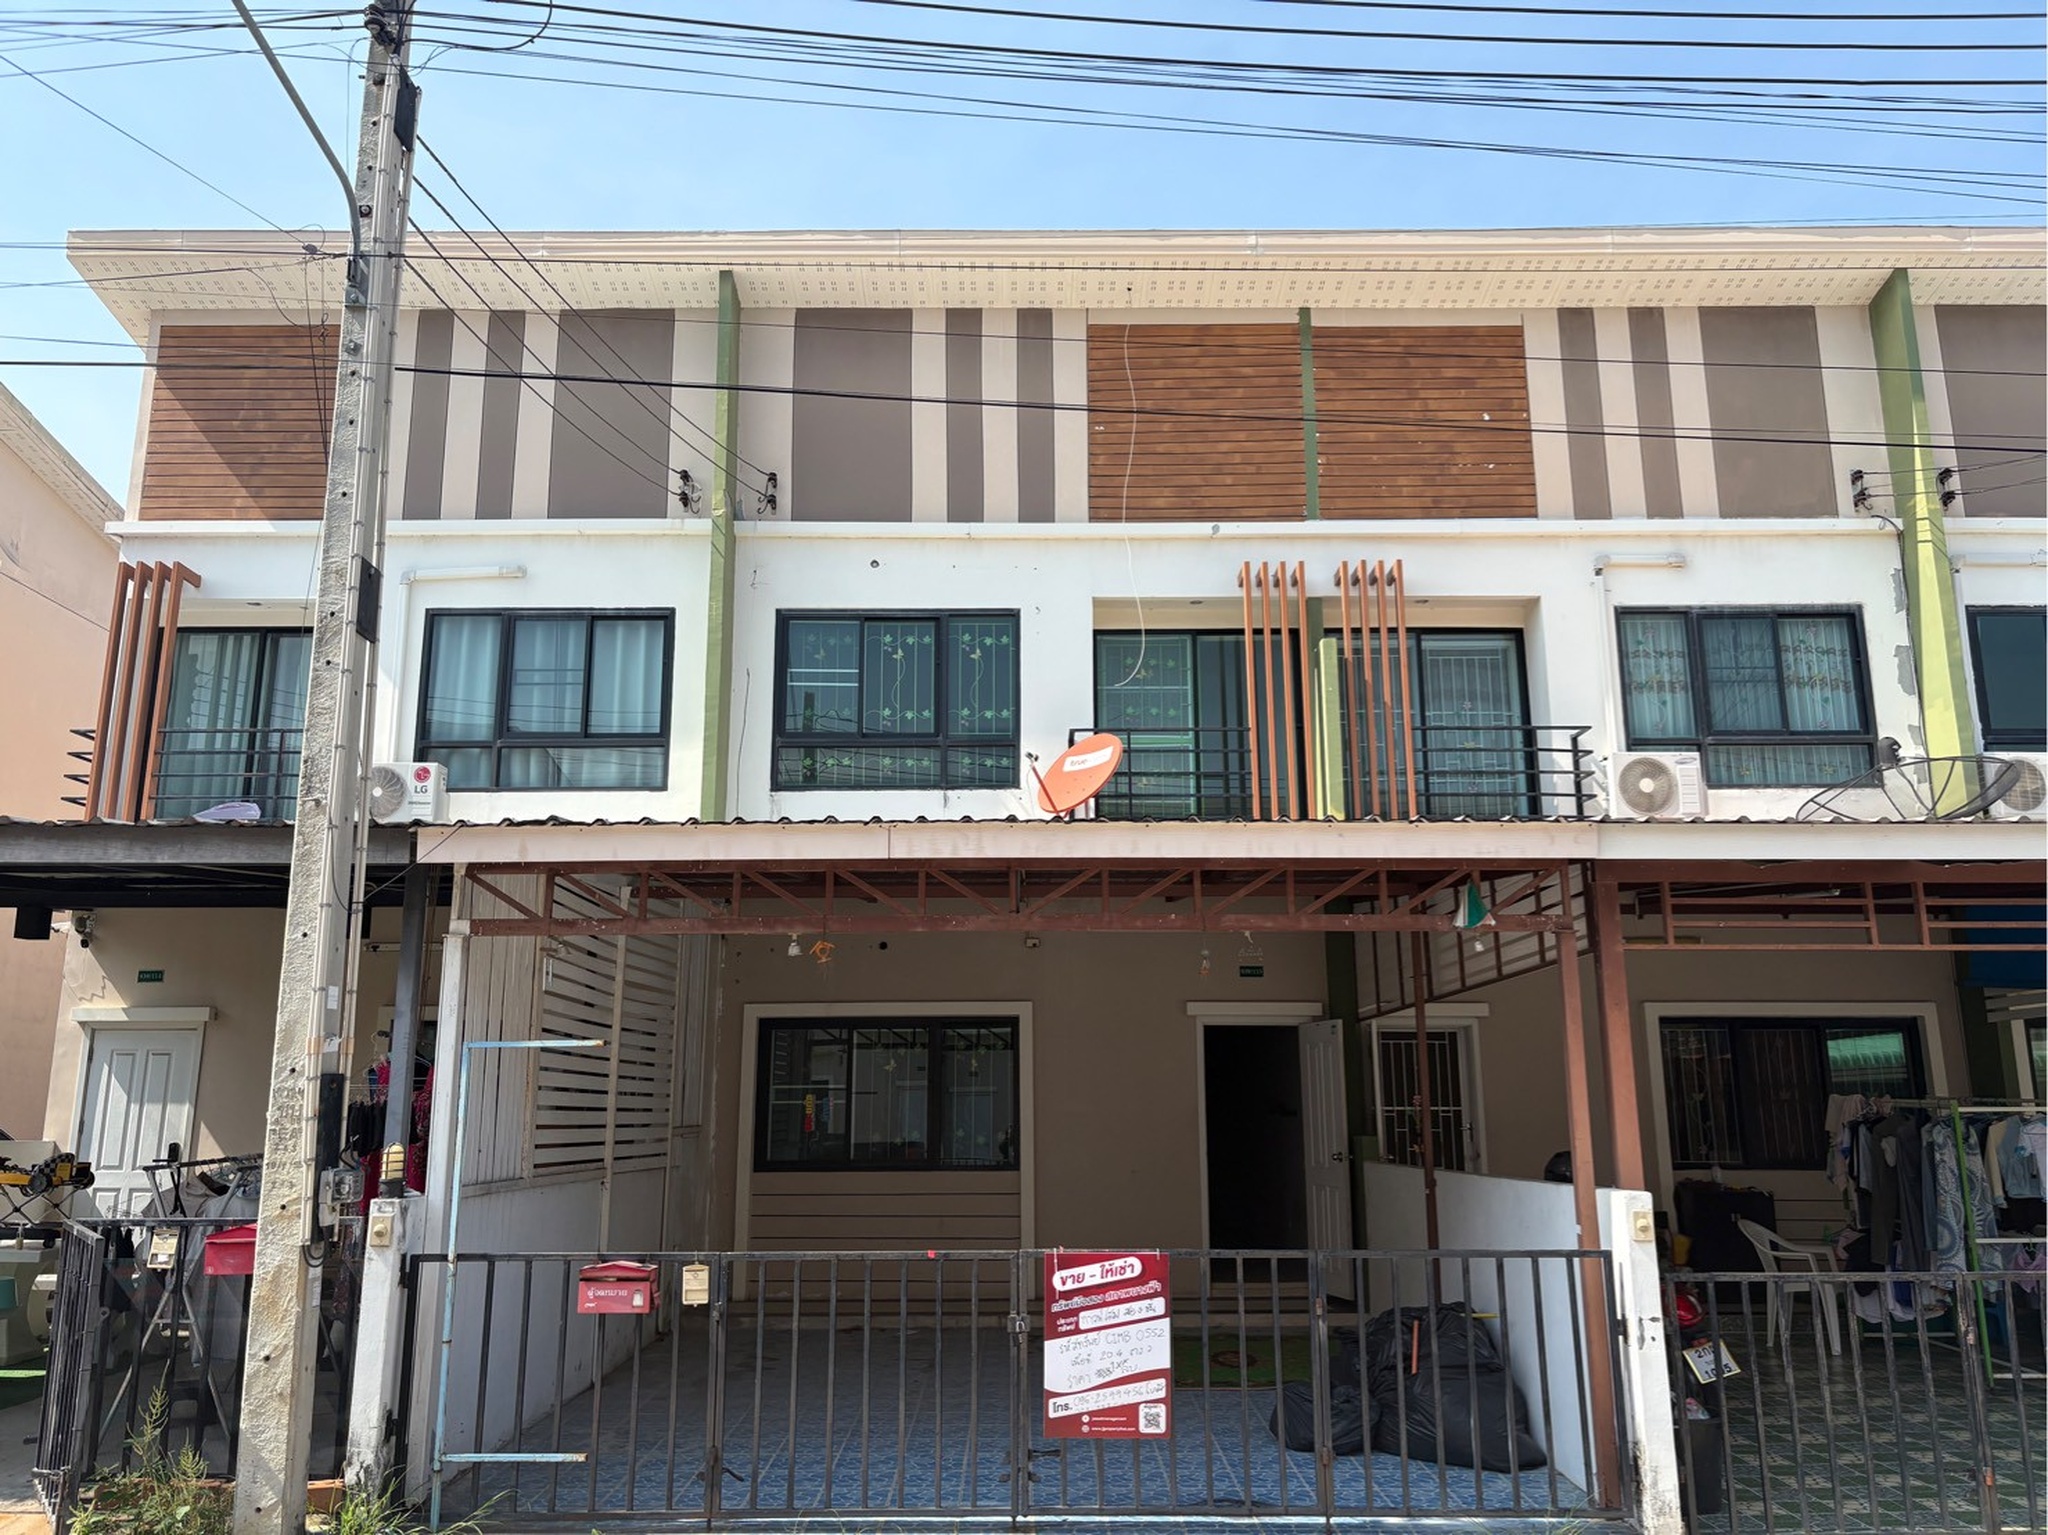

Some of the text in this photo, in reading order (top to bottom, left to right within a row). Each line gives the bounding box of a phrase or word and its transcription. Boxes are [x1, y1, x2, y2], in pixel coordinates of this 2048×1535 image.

[414, 785, 428, 794] LG
[1060, 1272, 1085, 1287] ขาย
[1100, 1260, 1135, 1280] ให้เช่า
[587, 1287, 628, 1299] ตู้จดหมาย
[1105, 1330, 1131, 1345] CIMB
[1136, 1328, 1165, 1342] 0552
[1704, 1362, 1732, 1379] 105
[1052, 1401, 1073, 1414] โทร.
